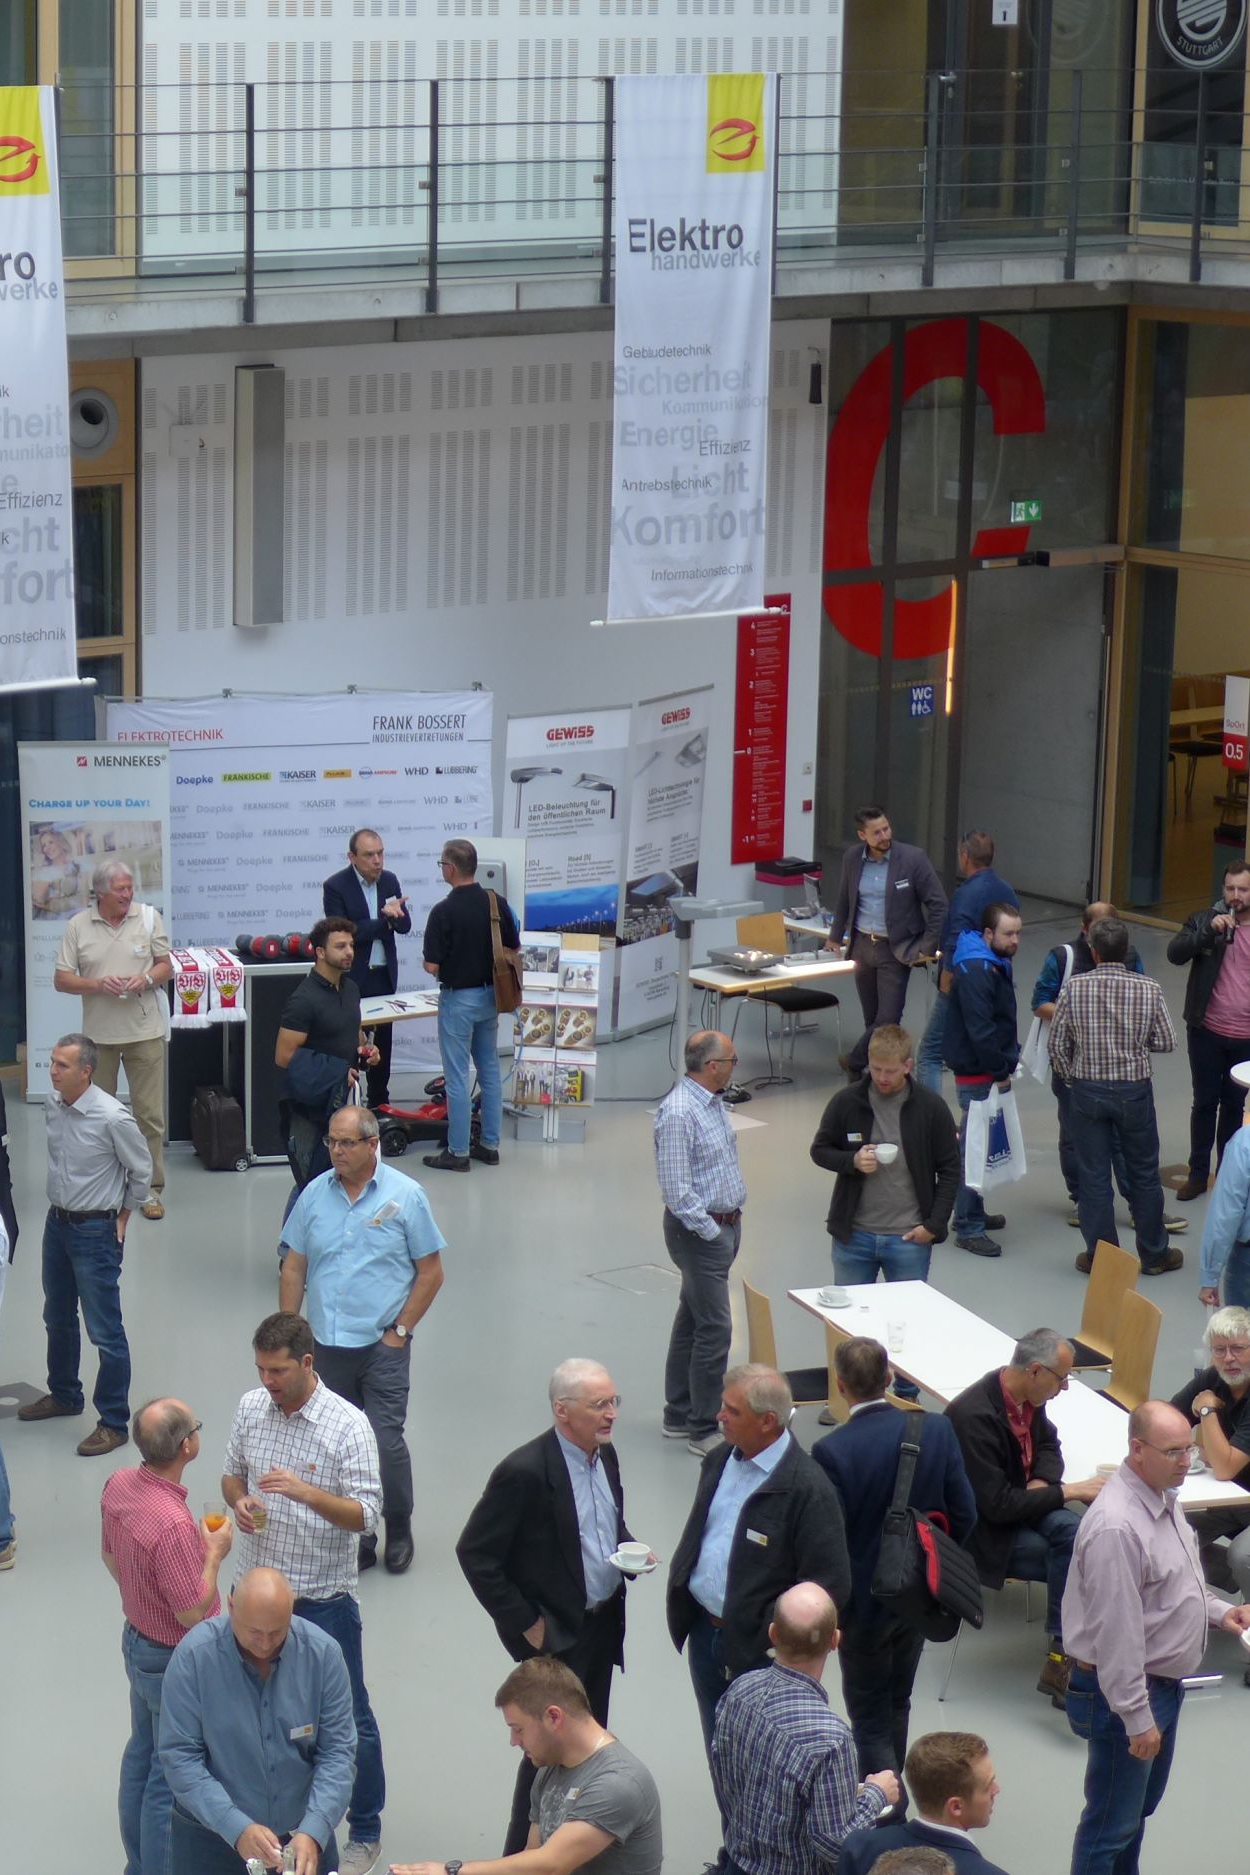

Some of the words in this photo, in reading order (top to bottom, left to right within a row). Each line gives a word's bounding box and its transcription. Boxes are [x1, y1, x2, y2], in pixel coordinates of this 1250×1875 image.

[628, 217, 744, 252] Elektro
[651, 247, 760, 271] handwerke
[620, 419, 718, 450] Energie
[672, 461, 749, 499] Licht
[612, 499, 765, 547] Komfort
[912, 686, 932, 700] WC
[372, 715, 413, 731] FRANK
[417, 714, 467, 730] BOSSERT
[117, 729, 224, 742] ELEKTROTECHNIK
[372, 732, 464, 743] INDUSTRIEVERTRETUNGEN
[1225, 742, 1244, 760] 0.5
[94, 755, 161, 767] MENNEKES
[286, 770, 316, 779] KAISER
[404, 767, 429, 776] WHD
[176, 775, 213, 786] Doepke
[306, 799, 336, 808] KAISER
[423, 796, 449, 804] WHD
[196, 804, 233, 815] Doepke
[326, 825, 356, 834] KAISER
[443, 822, 467, 831] WHD
[216, 830, 254, 840] Doepke
[236, 855, 273, 867] Doepke
[256, 882, 293, 893] Doepke
[275, 908, 312, 919] Doepke
